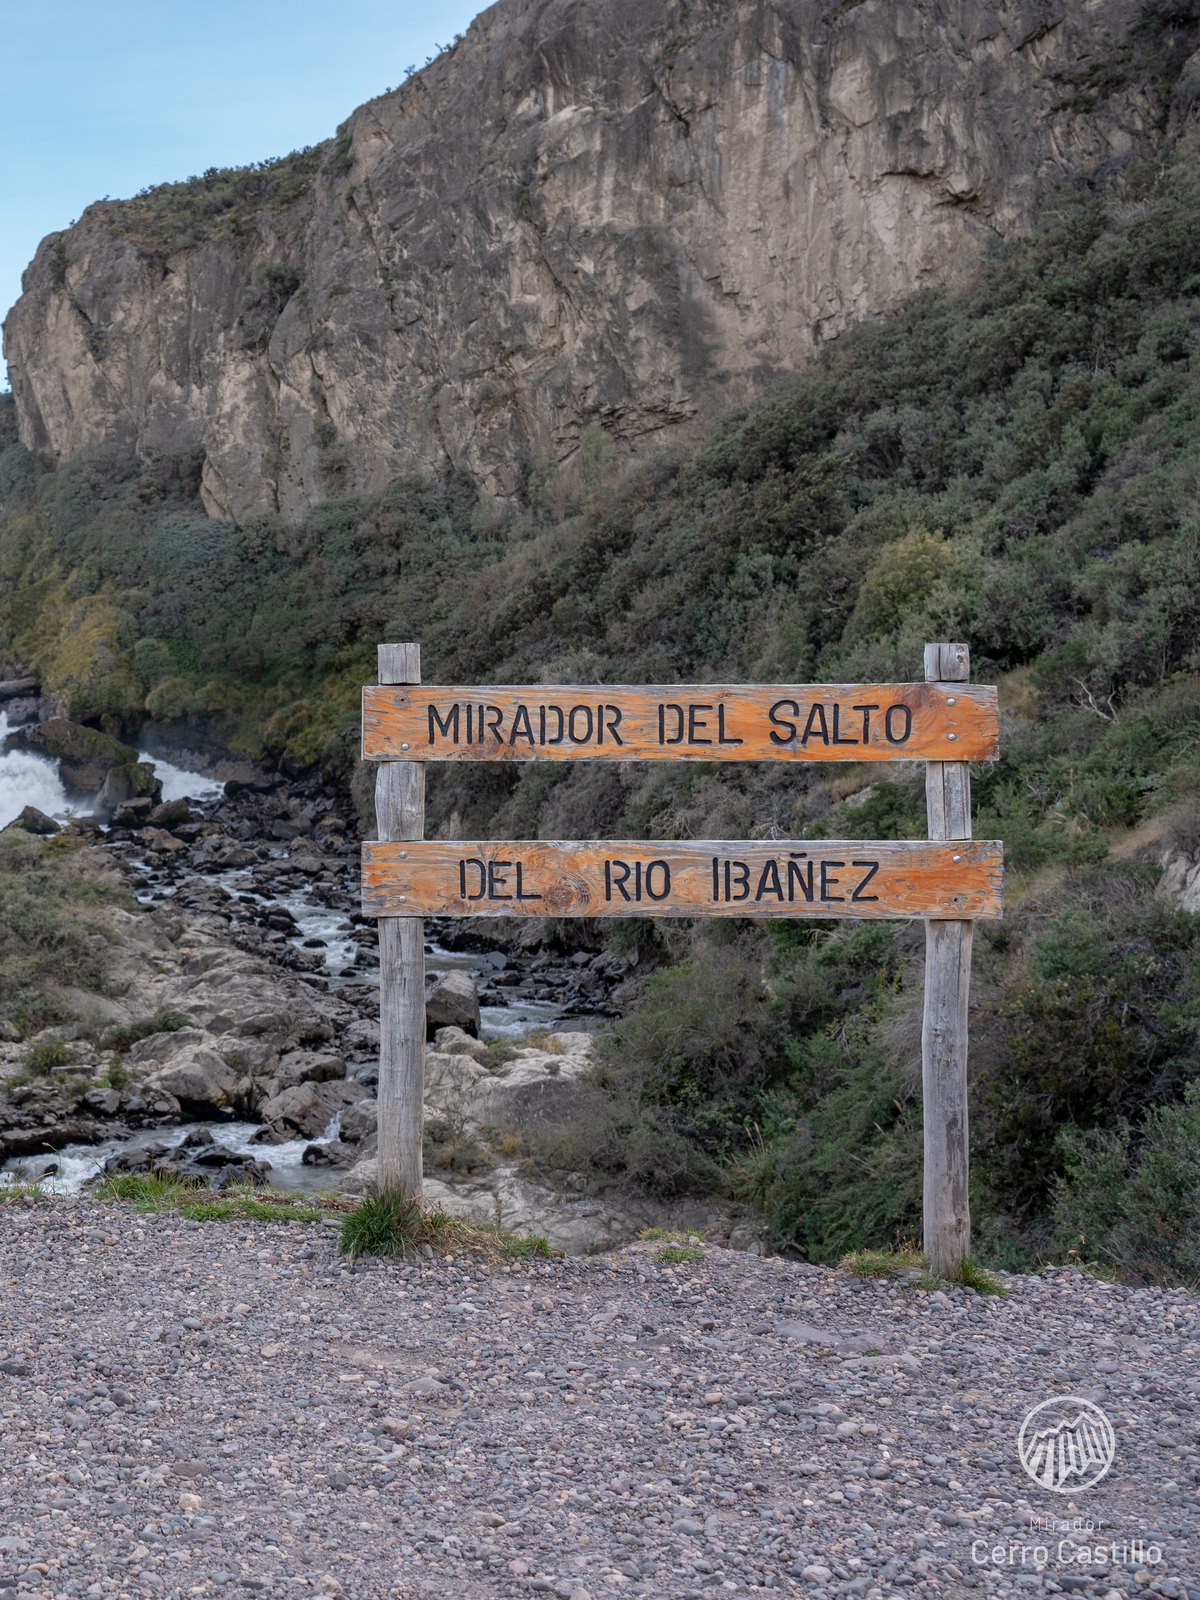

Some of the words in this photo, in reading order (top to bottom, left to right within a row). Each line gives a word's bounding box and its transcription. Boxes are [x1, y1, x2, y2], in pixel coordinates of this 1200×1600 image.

[427, 703, 623, 746] MIRADOR
[658, 704, 743, 746] DEL
[768, 699, 912, 746] SALTO
[458, 858, 542, 901] DEL
[604, 859, 672, 902] RIO
[712, 852, 880, 902] IBAÑEZ
